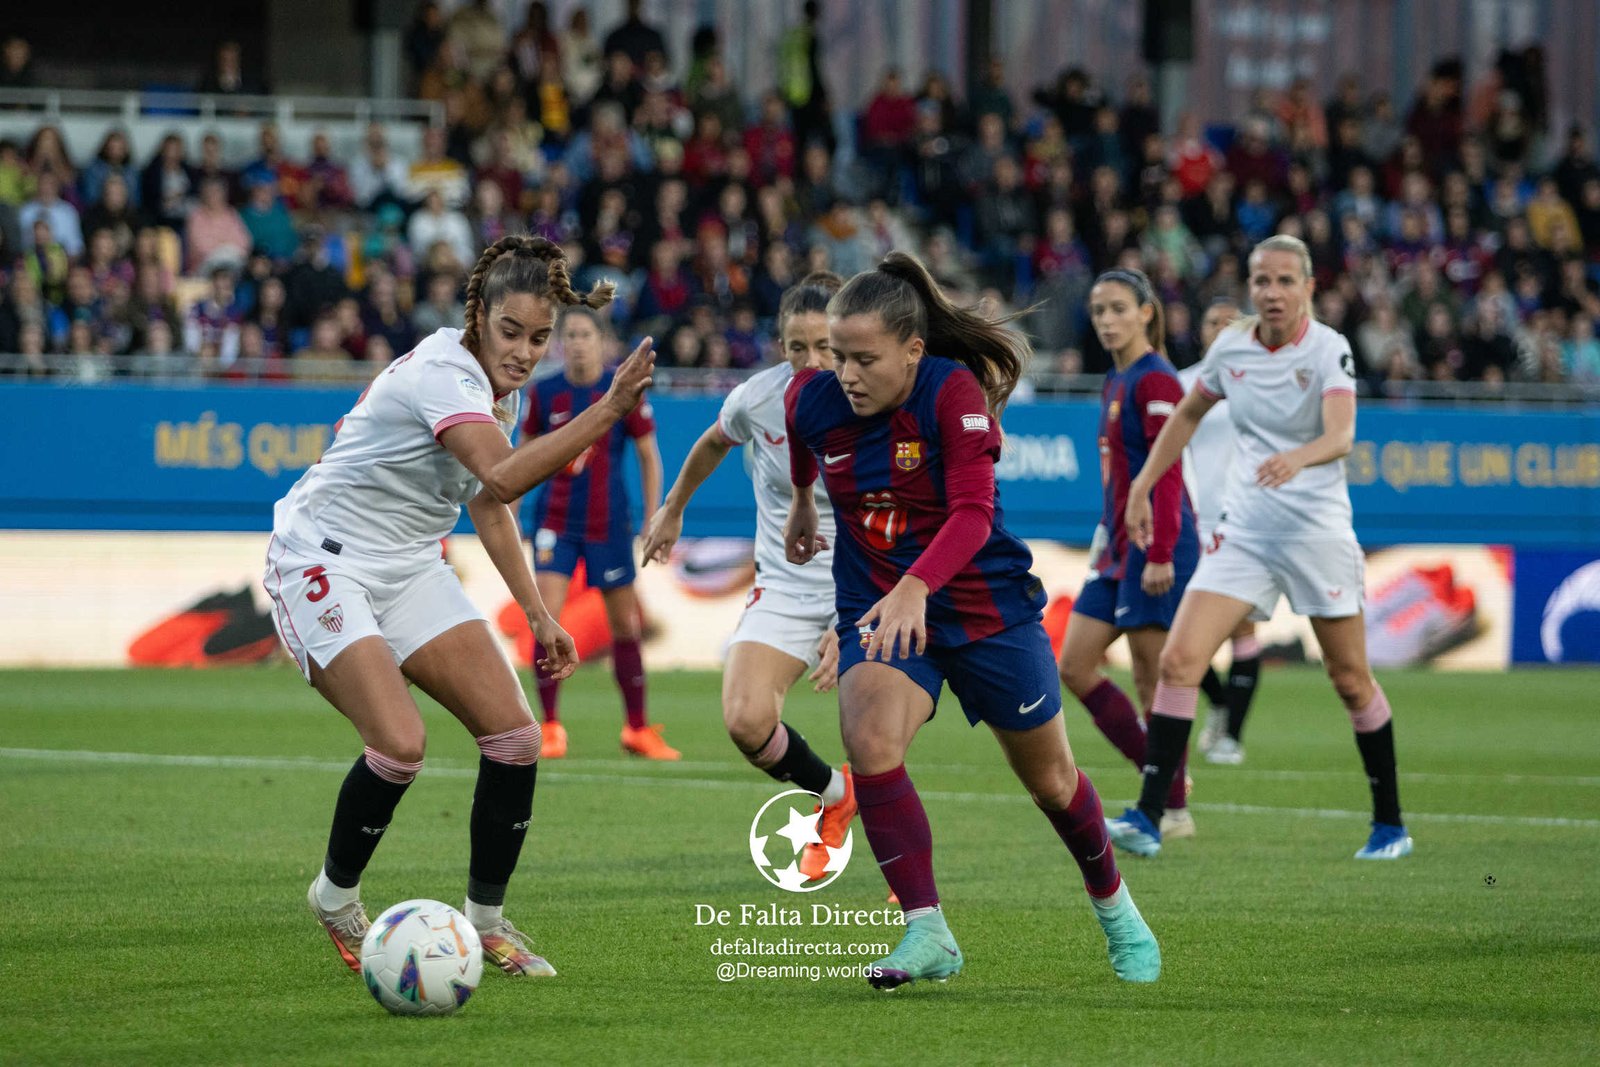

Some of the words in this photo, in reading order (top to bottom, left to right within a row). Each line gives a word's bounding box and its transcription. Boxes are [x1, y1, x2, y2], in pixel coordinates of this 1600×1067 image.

[155, 411, 244, 469] MÉS
[1381, 440, 1453, 492] QUE
[1457, 442, 1513, 487] UN
[303, 565, 330, 602] 3
